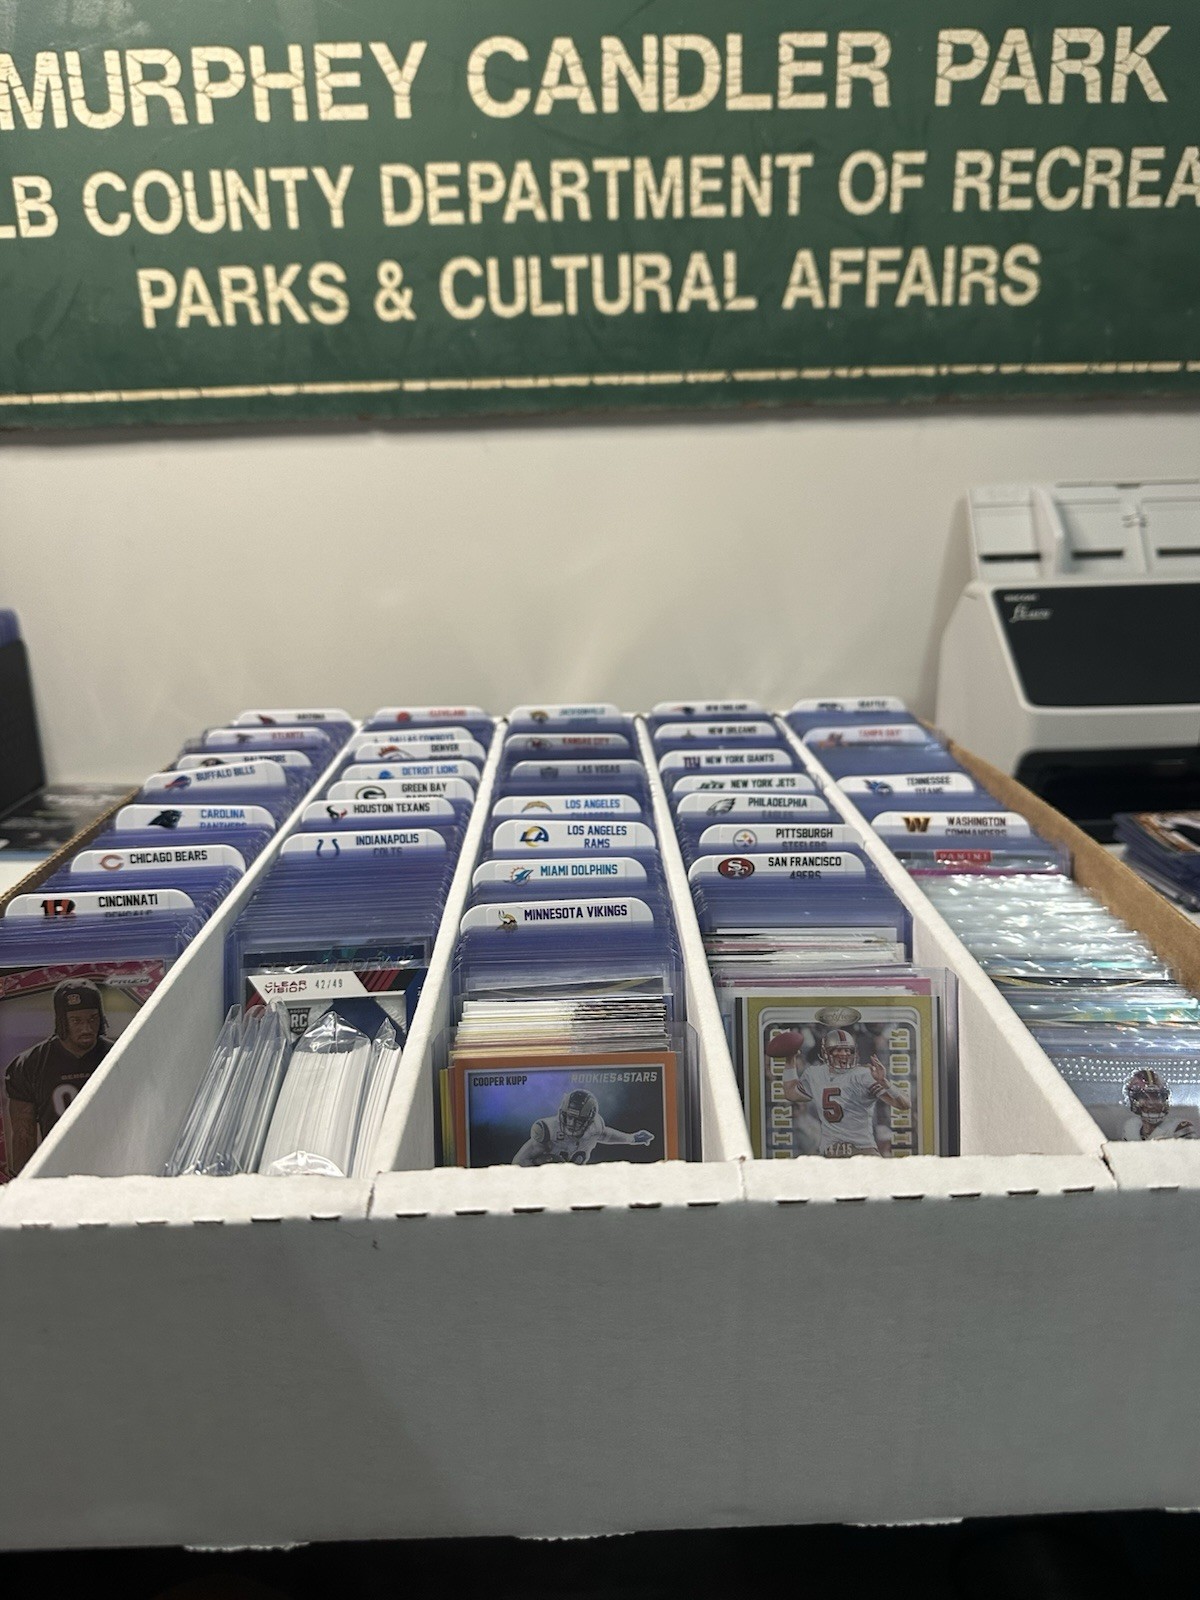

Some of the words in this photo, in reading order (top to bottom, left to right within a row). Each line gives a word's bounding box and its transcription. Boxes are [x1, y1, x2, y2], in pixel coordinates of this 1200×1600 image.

[0, 41, 427, 130] MURPHEY
[467, 32, 891, 118] CANDLER
[934, 26, 1171, 106] PARK
[82, 165, 354, 236] COUNTY
[379, 153, 814, 227] DEPARTMENT
[838, 150, 927, 216] OF
[952, 146, 1200, 212] RECREA
[136, 261, 349, 328] PARKS
[374, 260, 416, 323] &
[439, 251, 757, 321] CULTURAL
[782, 243, 1042, 310] AFFAIRS
[708, 727, 723, 735] NEW
[431, 743, 459, 753] DENVER
[705, 755, 722, 764] NEW
[725, 754, 745, 764] YORK
[747, 753, 775, 763] GIANTS
[195, 768, 232, 782] BUFFALO
[233, 765, 256, 777] BILLS
[402, 766, 434, 776] DETROIT
[436, 764, 459, 775] LIONS
[577, 765, 593, 774] LAS
[595, 764, 621, 774] VEGAS
[730, 779, 748, 789] NEW
[751, 778, 773, 788] YORK
[775, 777, 796, 788] JETS
[905, 775, 951, 786] TENNESSEE
[401, 783, 427, 793] GREEN
[430, 782, 447, 792] BAY
[353, 803, 394, 814] HOUSTON
[396, 802, 431, 813] TEXANS
[565, 799, 582, 809] LOS
[584, 798, 621, 809] ANGELES
[748, 796, 808, 808] PHILADELPHIA
[200, 808, 246, 820] CAROLINA
[946, 816, 1006, 826] WASHINGTON
[567, 825, 584, 836] LOS
[587, 825, 627, 836] ANGELES
[776, 828, 833, 839] PITTSBURGH
[356, 833, 419, 845] INDIANAPOLIS
[584, 838, 610, 849] RAMS
[130, 852, 173, 864] CHICAGO
[175, 850, 208, 863] BEARS
[768, 856, 787, 868] SAN
[790, 856, 842, 867] FRANCISCO
[939, 852, 988, 860] PANINI
[540, 865, 569, 876] MIAMI
[571, 864, 618, 875] DOLPHINS
[98, 893, 158, 907] CINCINNATI
[524, 907, 583, 921] MINNESOTA
[586, 904, 628, 917] VIKINGS
[264, 980, 307, 988] CLEAR
[315, 978, 343, 989] 42/49
[264, 986, 308, 994] VISION
[290, 1013, 308, 1028] RC
[473, 1075, 505, 1087] COOPER
[506, 1074, 528, 1086] KUPP
[822, 1087, 844, 1124] 5
